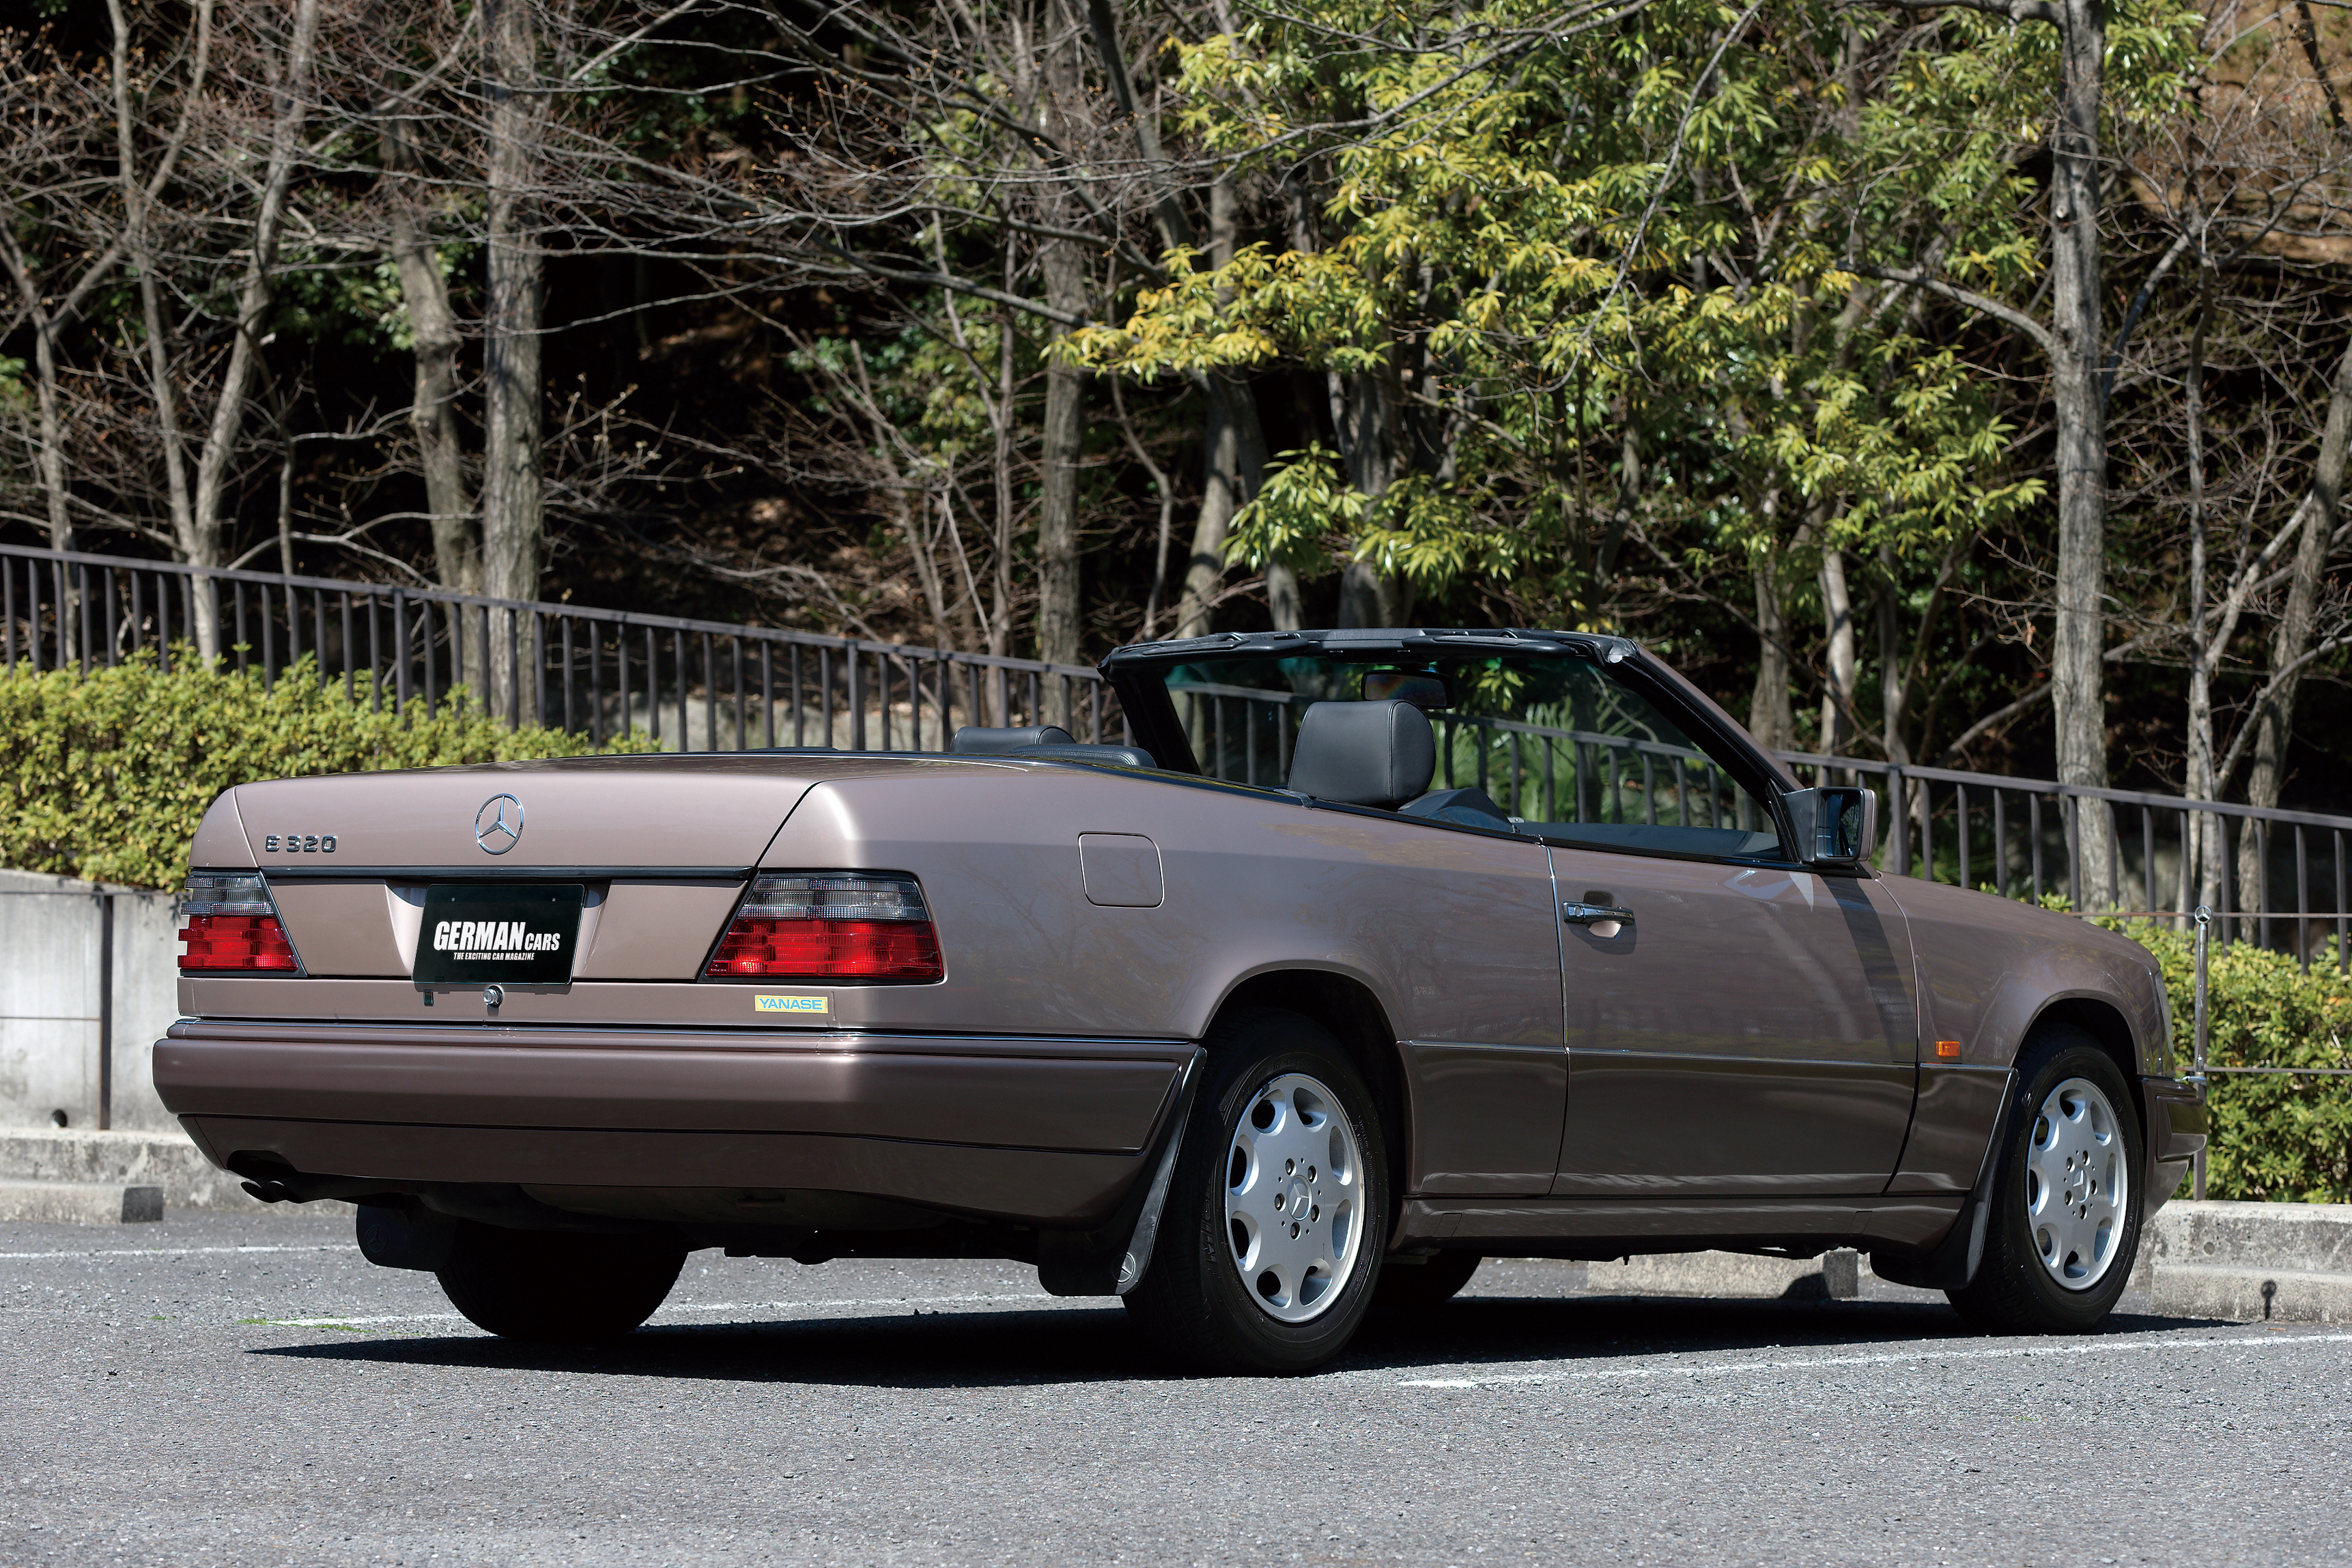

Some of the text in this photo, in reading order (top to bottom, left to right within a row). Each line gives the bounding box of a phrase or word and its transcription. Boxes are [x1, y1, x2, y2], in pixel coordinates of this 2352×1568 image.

[266, 835, 338, 853] E 320
[433, 921, 561, 951] GERMAN CARS
[453, 952, 535, 960] THE EXCITING CAR MAGAZINE
[759, 998, 823, 1010] YANASE
